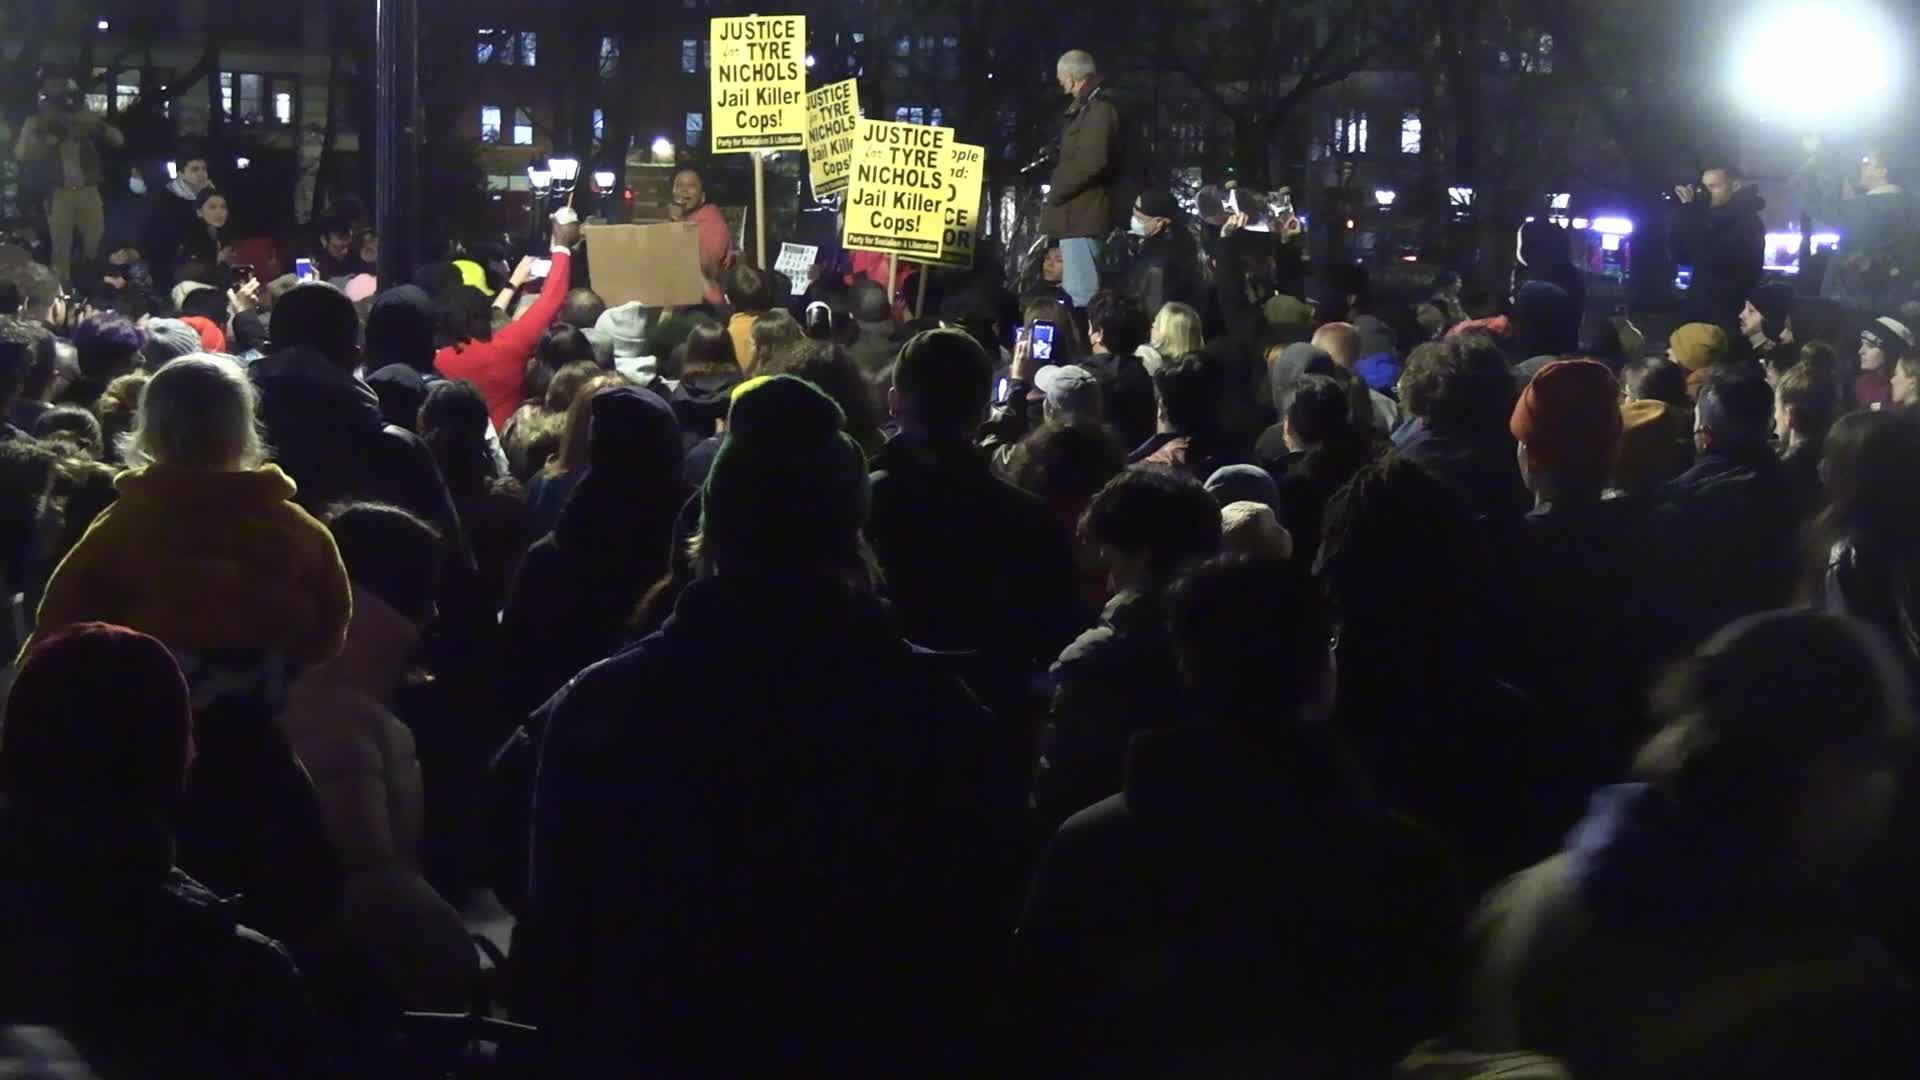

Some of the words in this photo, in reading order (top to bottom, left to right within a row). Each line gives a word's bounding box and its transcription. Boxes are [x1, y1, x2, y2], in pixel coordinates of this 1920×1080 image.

[720, 20, 795, 40] JUSTICE
[747, 41, 791, 60] TYRE
[719, 62, 798, 82] NICHOLS
[717, 88, 749, 107] Jail
[756, 87, 800, 106] Killer
[806, 83, 851, 111] JUSTICE
[736, 109, 782, 133] Cops!
[819, 100, 850, 122] TYRE
[809, 115, 856, 144] NICHOLS
[863, 124, 944, 149] JUSTICE
[811, 144, 828, 163] Jail
[889, 147, 938, 168] TYRE
[858, 164, 943, 190] NICHOLS
[853, 188, 886, 208] Jail
[893, 191, 942, 213] Killer
[870, 210, 921, 235] Cops!
